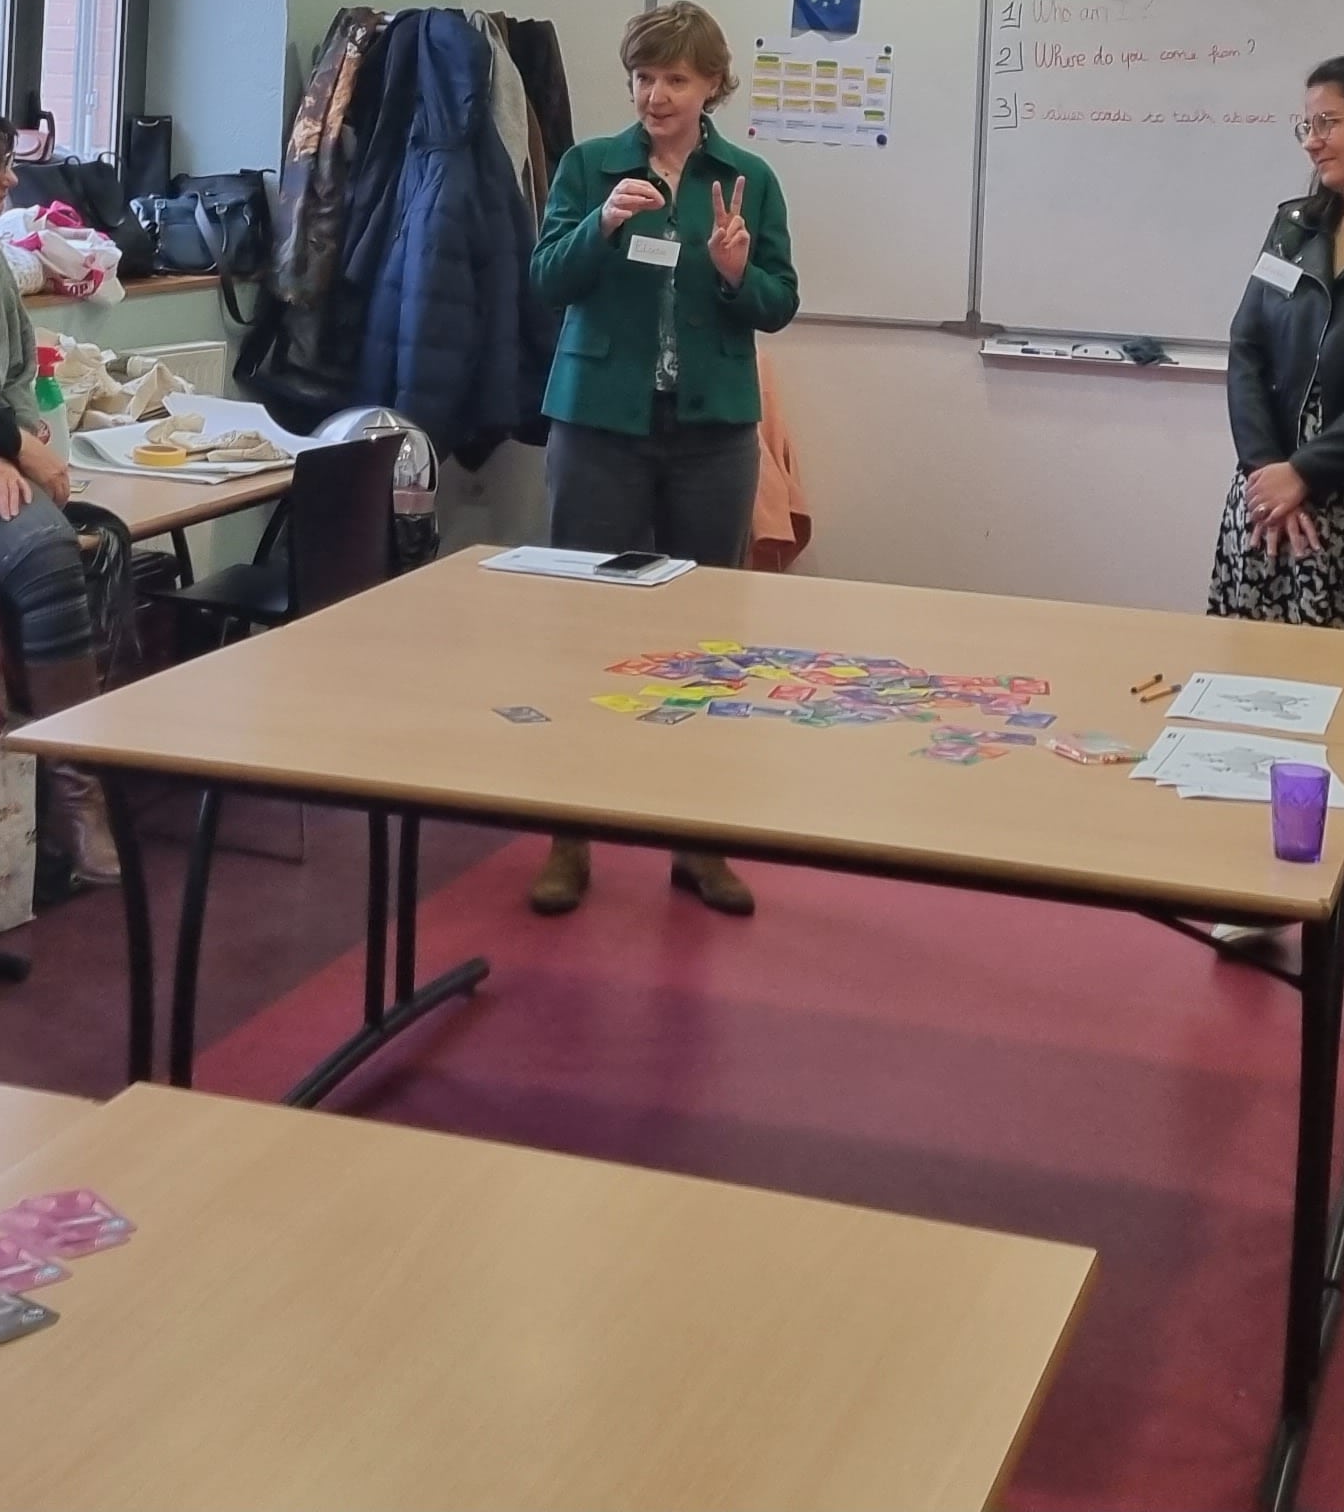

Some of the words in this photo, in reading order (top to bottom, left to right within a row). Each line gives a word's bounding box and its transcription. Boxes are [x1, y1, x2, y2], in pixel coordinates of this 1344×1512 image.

[1080, 6, 1109, 23] am
[1034, 40, 1087, 69] Where
[1093, 45, 1113, 66] do
[1121, 53, 1148, 70] you
[1160, 50, 1198, 62] come
